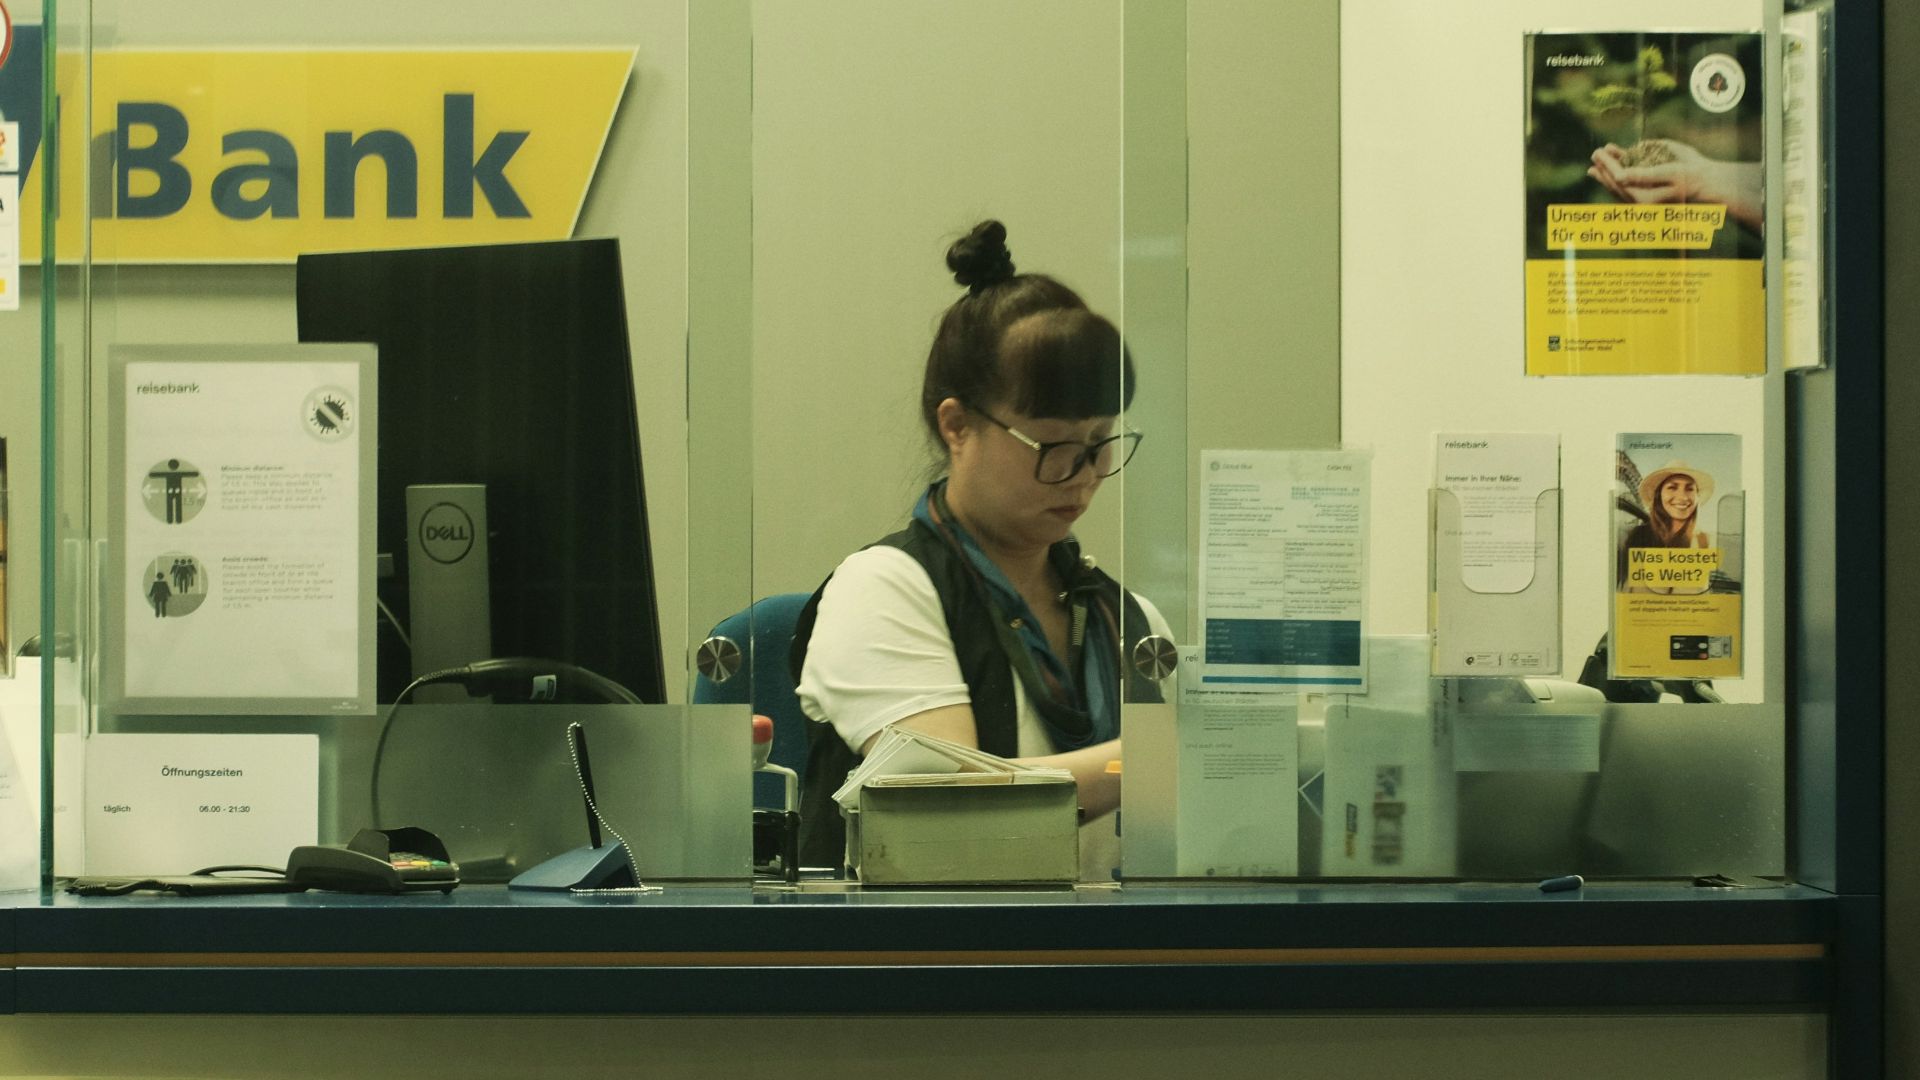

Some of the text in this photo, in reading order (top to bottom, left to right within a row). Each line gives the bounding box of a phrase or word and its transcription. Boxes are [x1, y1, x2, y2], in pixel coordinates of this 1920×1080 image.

[1546, 54, 1604, 67] reisebank
[117, 93, 531, 221] Bank
[1552, 206, 1721, 230] Unser aktiver Beitrag
[1552, 228, 1708, 246] für ein gutes Klima.
[136, 382, 200, 394] reisebank
[1444, 440, 1488, 449] reisebank
[1629, 440, 1673, 450] reisebank
[426, 525, 469, 541] DELL
[1631, 550, 1718, 564] Was kostet
[1631, 568, 1704, 582] die Welt?
[160, 766, 243, 779] Öffnungszeiten
[103, 804, 131, 814] täglich
[198, 804, 221, 814] 06.00
[228, 804, 250, 814] 21:30
